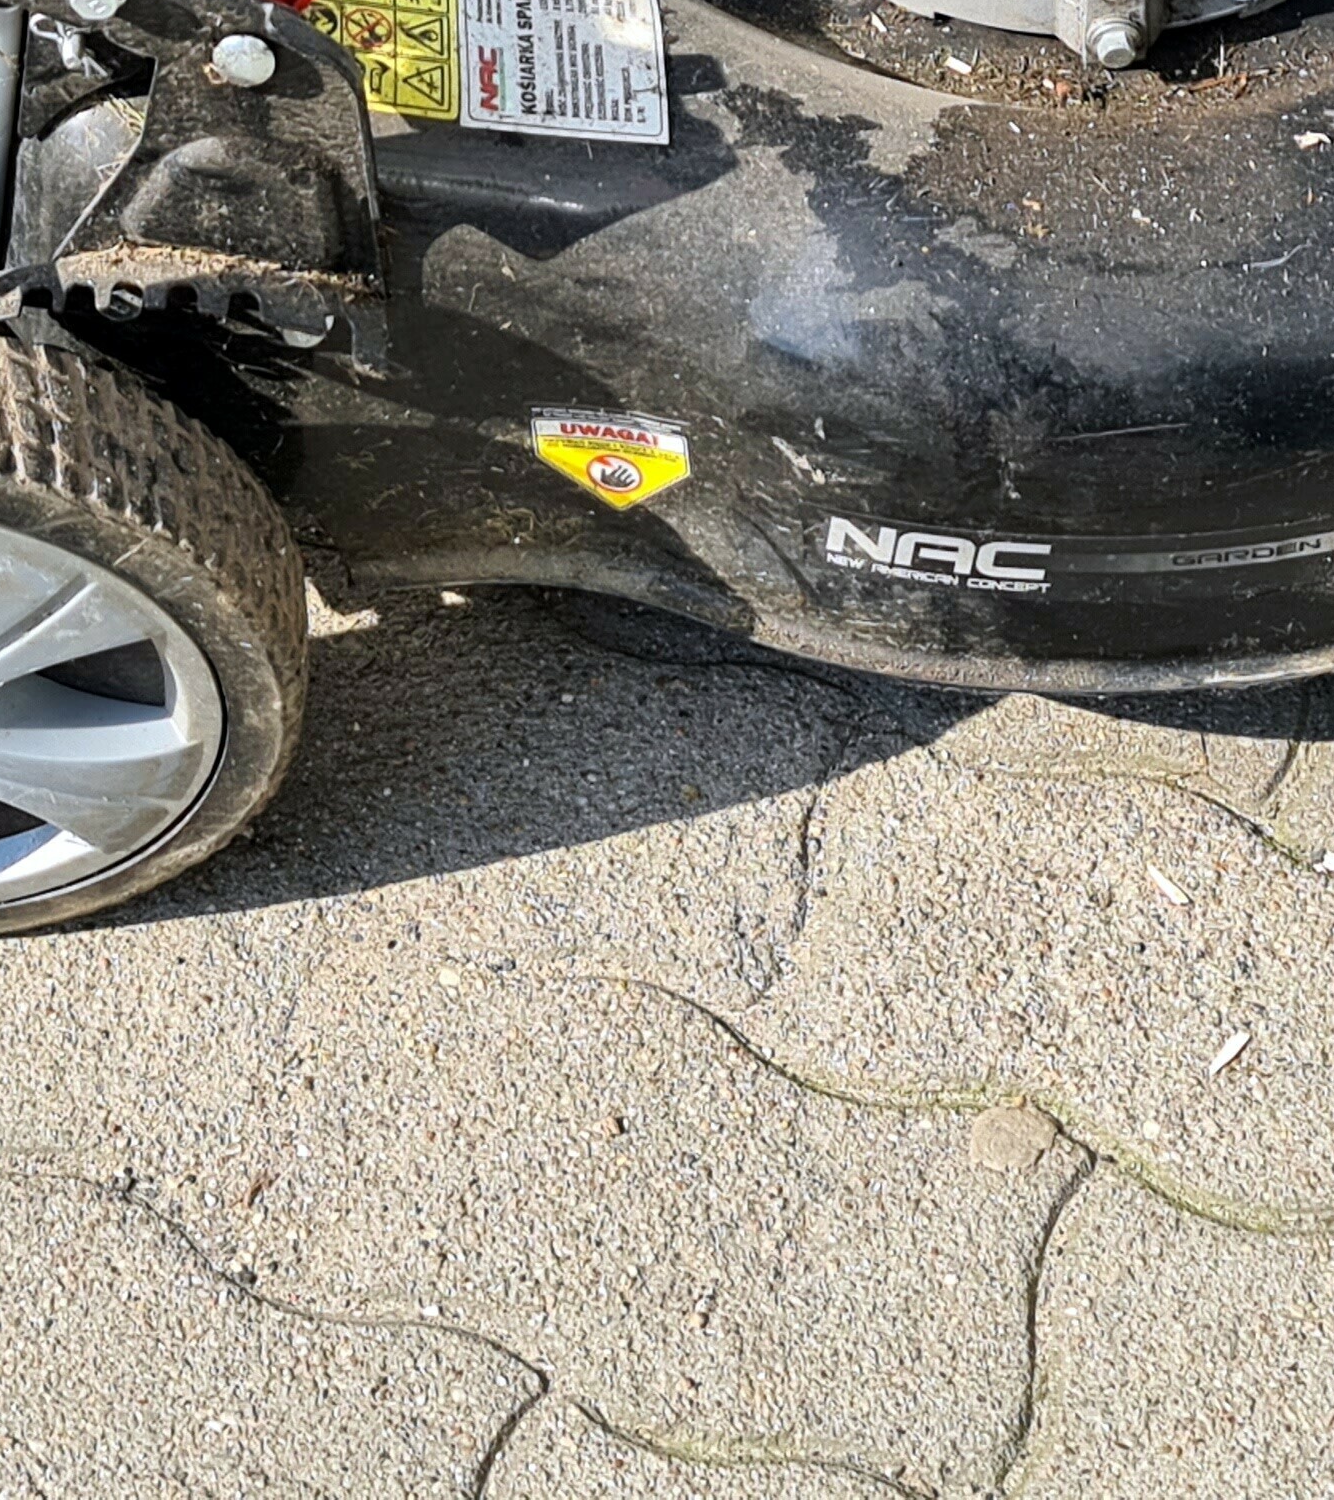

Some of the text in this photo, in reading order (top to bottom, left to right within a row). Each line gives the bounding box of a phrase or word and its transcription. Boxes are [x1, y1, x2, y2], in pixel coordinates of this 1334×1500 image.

[478, 45, 499, 112] NAC
[559, 423, 659, 446] UWAGA!
[825, 516, 1052, 581] NAC
[1172, 535, 1322, 566] GARDEN
[826, 552, 1051, 594] NEW AMERICAN CONCEPT
